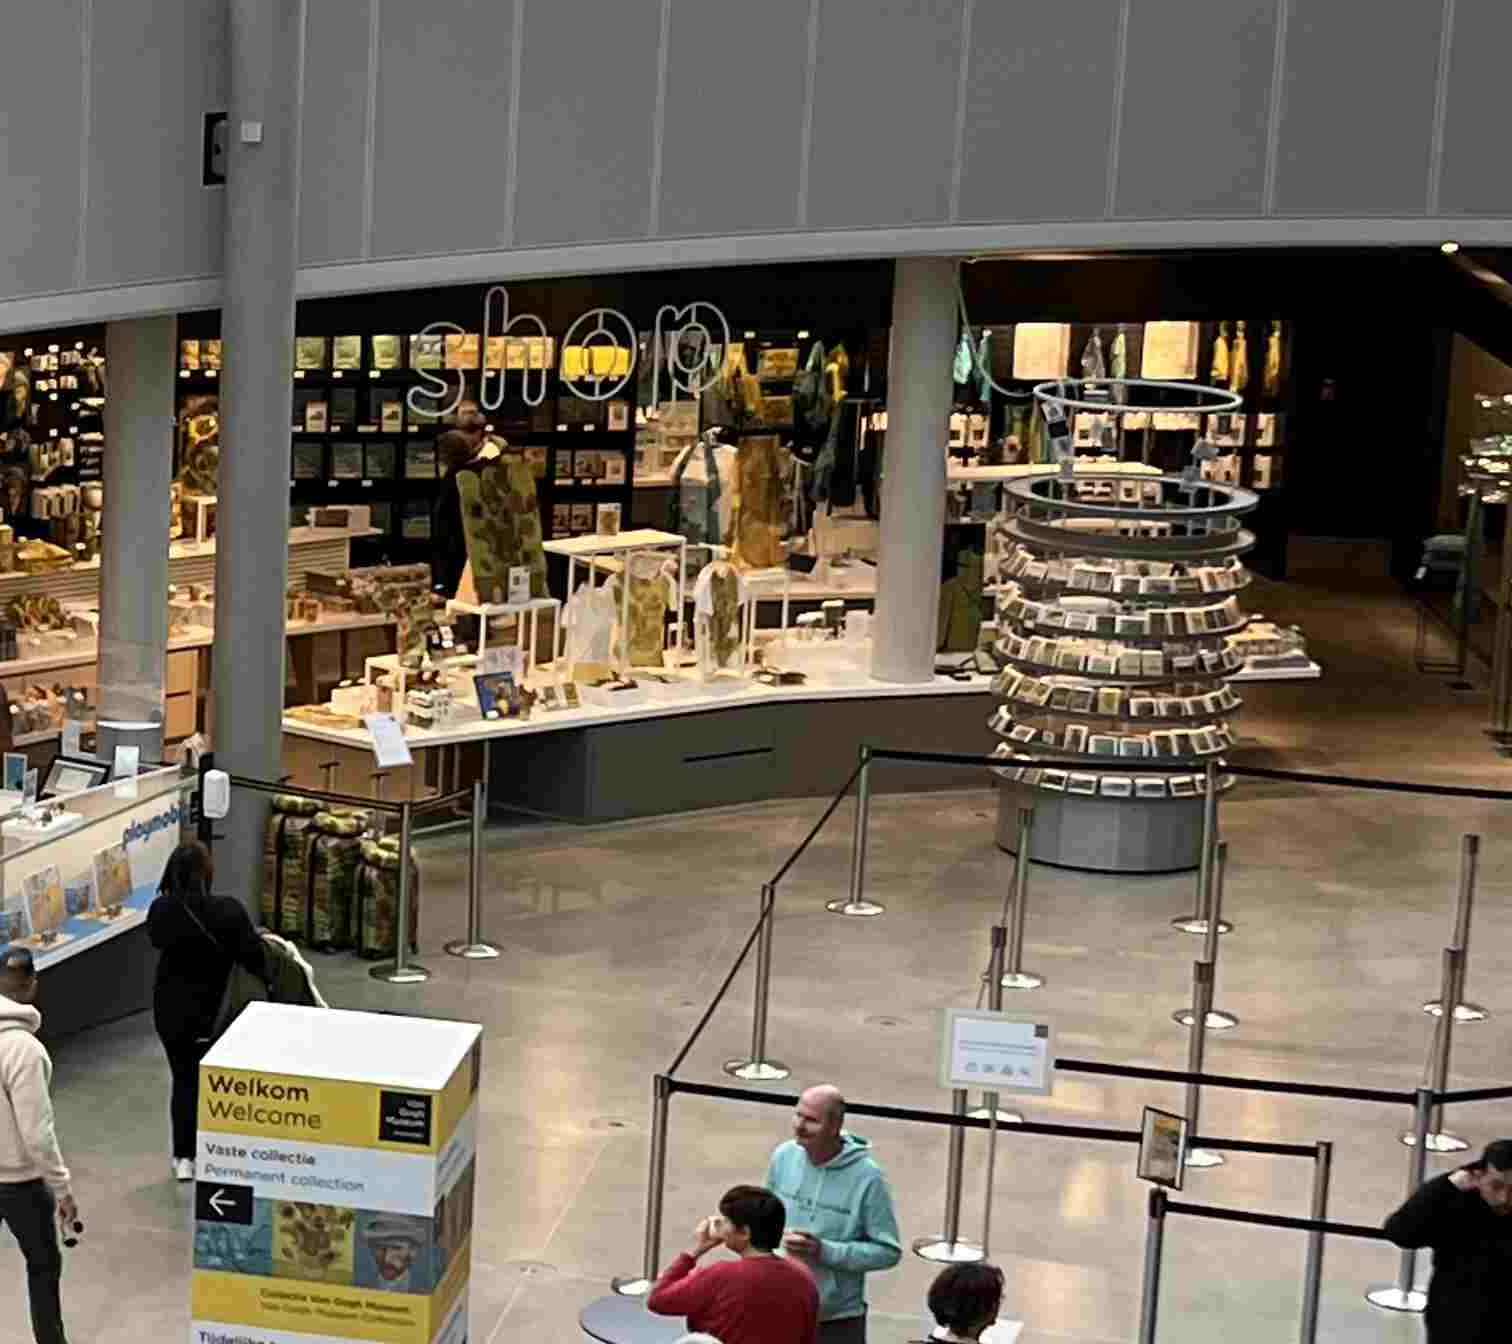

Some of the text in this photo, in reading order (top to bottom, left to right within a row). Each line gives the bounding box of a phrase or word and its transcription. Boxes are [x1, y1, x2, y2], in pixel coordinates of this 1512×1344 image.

[406, 285, 731, 417] shop
[207, 1073, 310, 1102] Welkom
[207, 1099, 322, 1130] Welcome
[205, 1142, 316, 1166] Vaste collectie
[204, 1162, 366, 1193] Permanent collection
